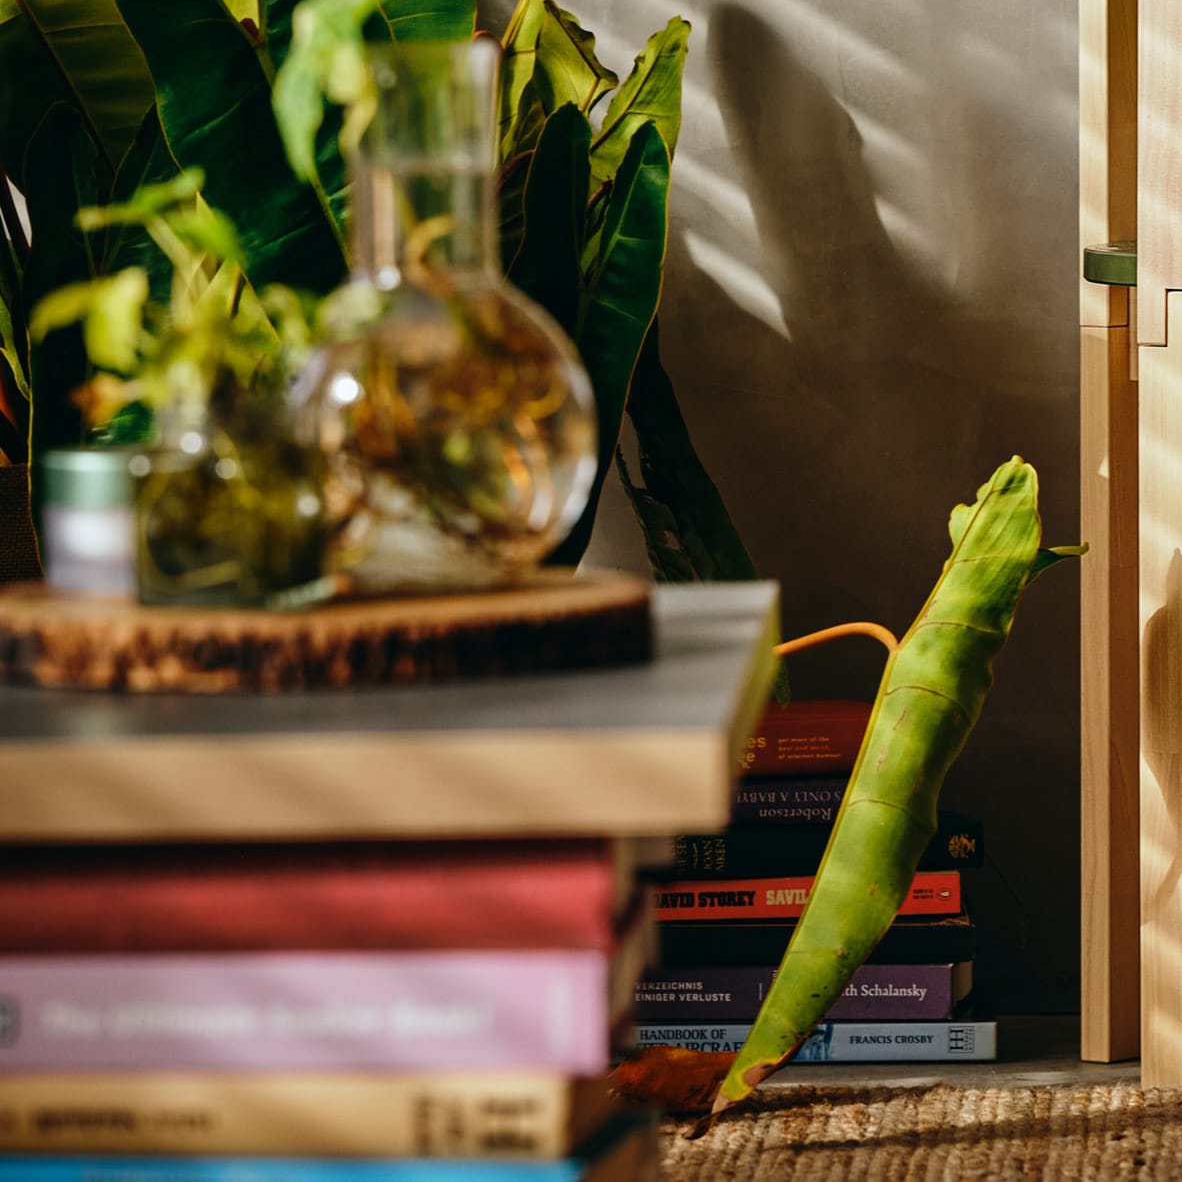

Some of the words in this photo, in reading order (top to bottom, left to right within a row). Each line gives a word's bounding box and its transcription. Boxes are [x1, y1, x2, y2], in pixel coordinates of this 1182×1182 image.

[780, 791, 789, 802] A
[794, 791, 831, 803] ONLY
[759, 808, 832, 821] Robertson
[698, 891, 756, 908] STOREY
[636, 982, 703, 991] VERZEICHNIS
[860, 984, 928, 1001] Schalansky
[635, 993, 676, 1002] EINIGER
[679, 993, 732, 1002] VERLUSTE
[640, 1029, 709, 1041] HANDBOOK
[711, 1028, 727, 1040] OF
[850, 1035, 893, 1045] FRANCIS
[895, 1034, 934, 1044] CROSBY
